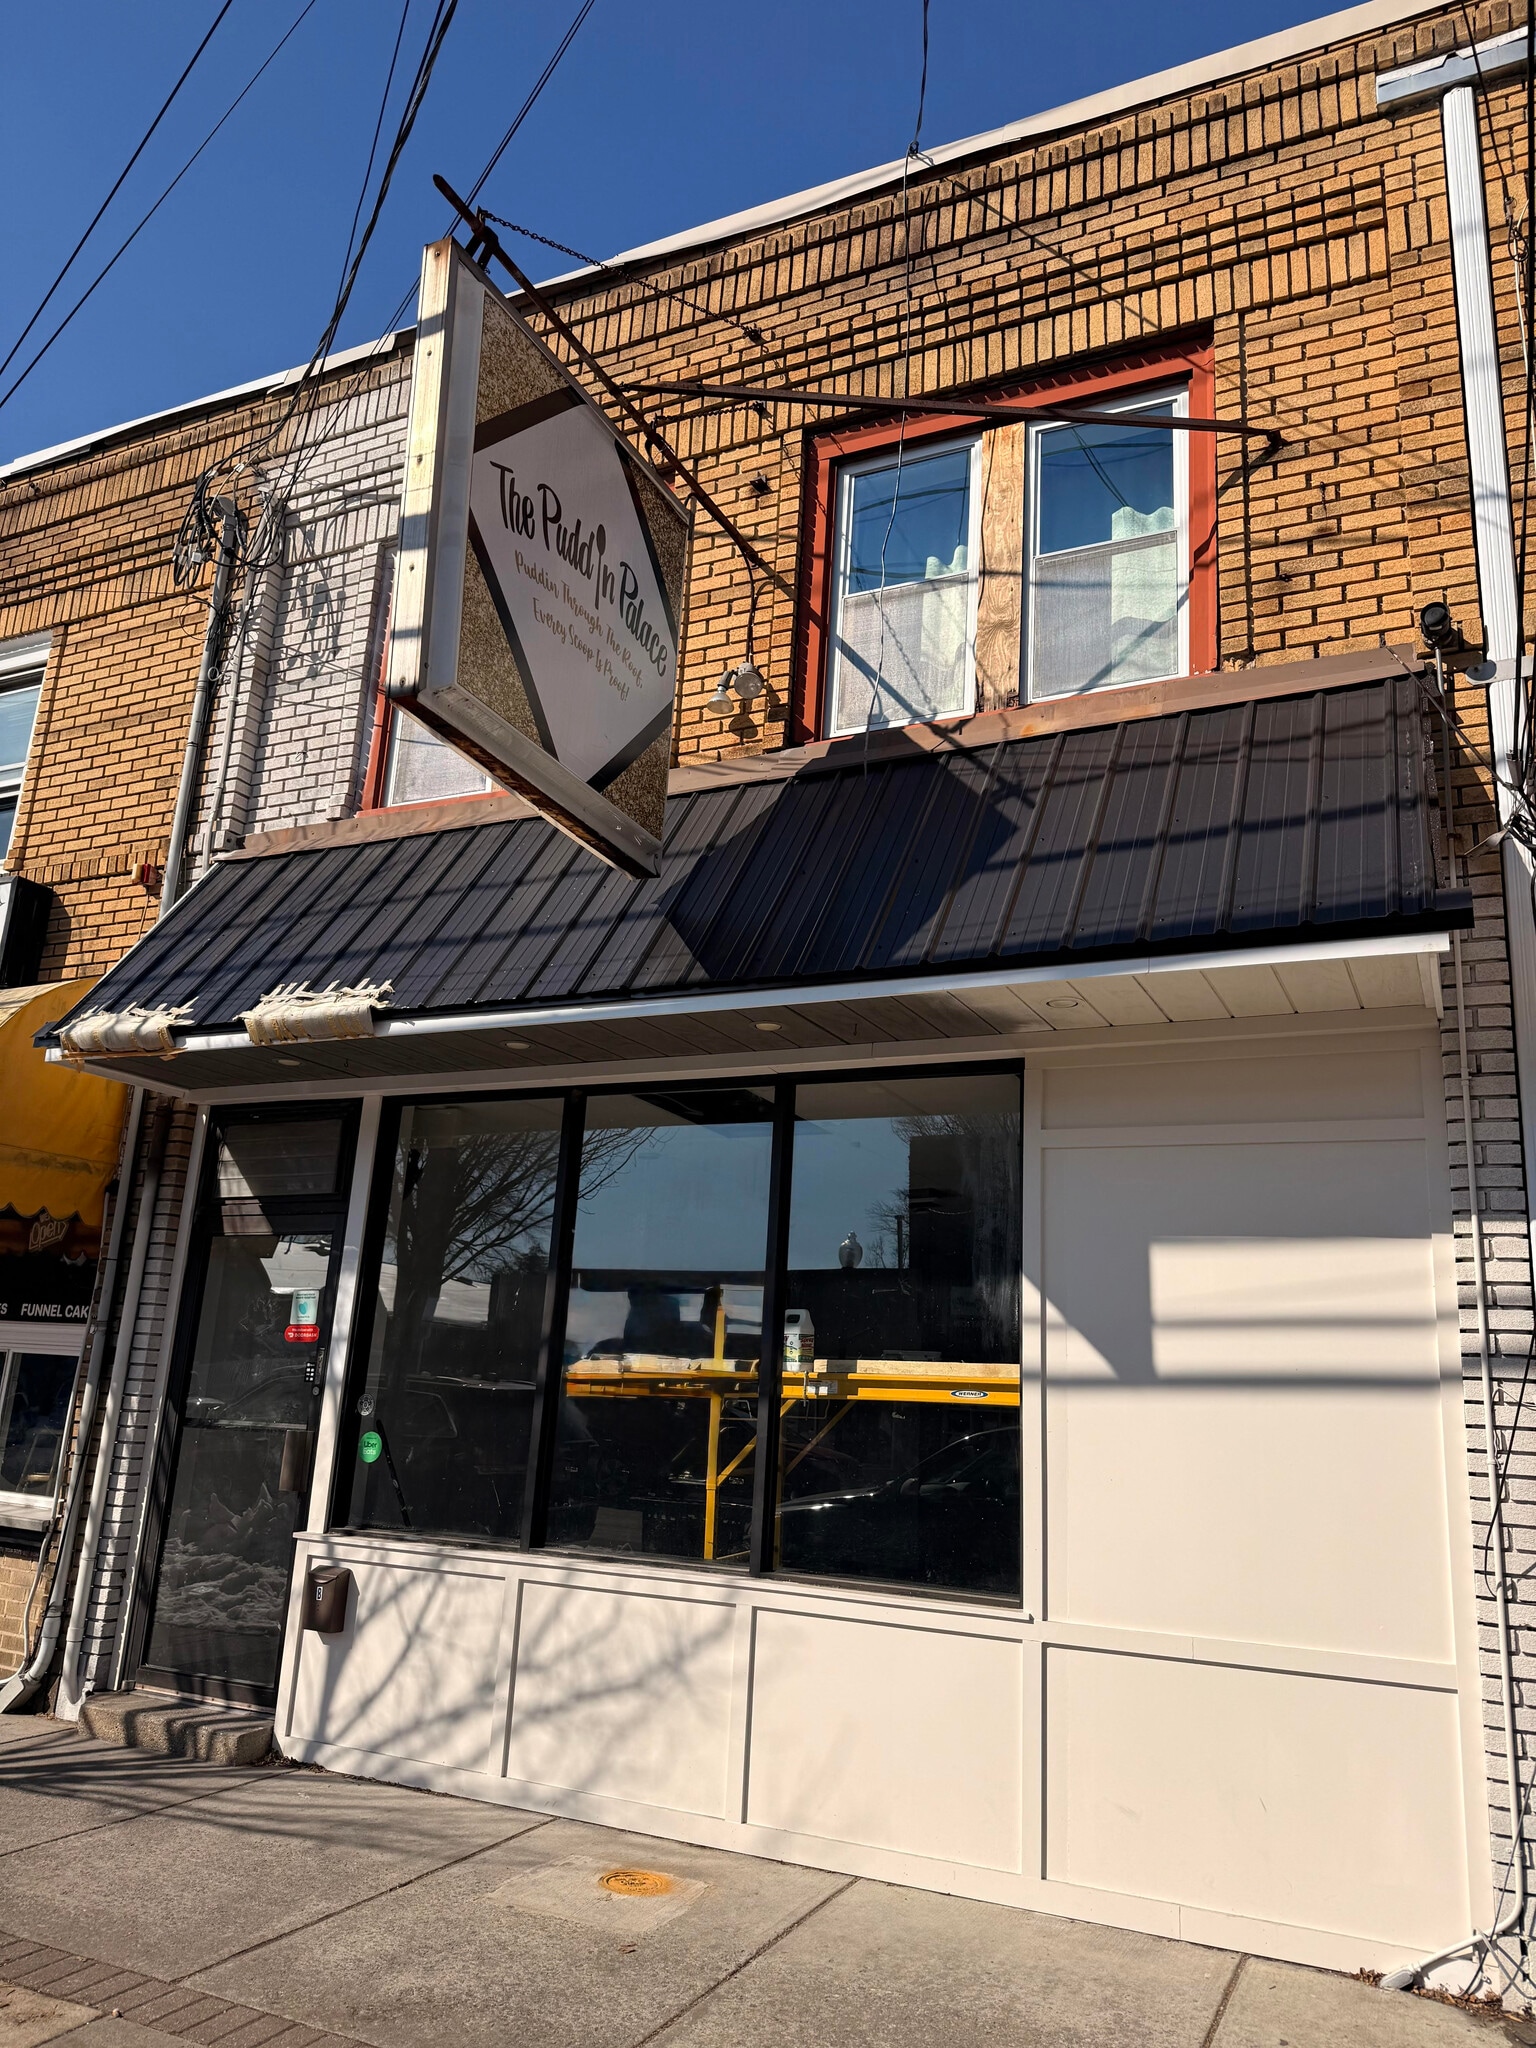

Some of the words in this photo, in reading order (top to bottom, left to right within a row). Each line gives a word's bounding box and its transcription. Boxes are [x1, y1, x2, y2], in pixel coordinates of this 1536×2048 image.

[490, 460, 535, 540] The
[620, 561, 667, 677] Palace
[514, 549, 560, 599] Puddin
[561, 580, 603, 637] Through
[606, 623, 621, 656] The
[621, 648, 643, 688] Roof,
[568, 624, 594, 663] Scoop
[595, 647, 603, 673] Is
[603, 658, 630, 702] Proof!
[20, 1303, 63, 1318] FUNNEL
[65, 1305, 89, 1319] CAK
